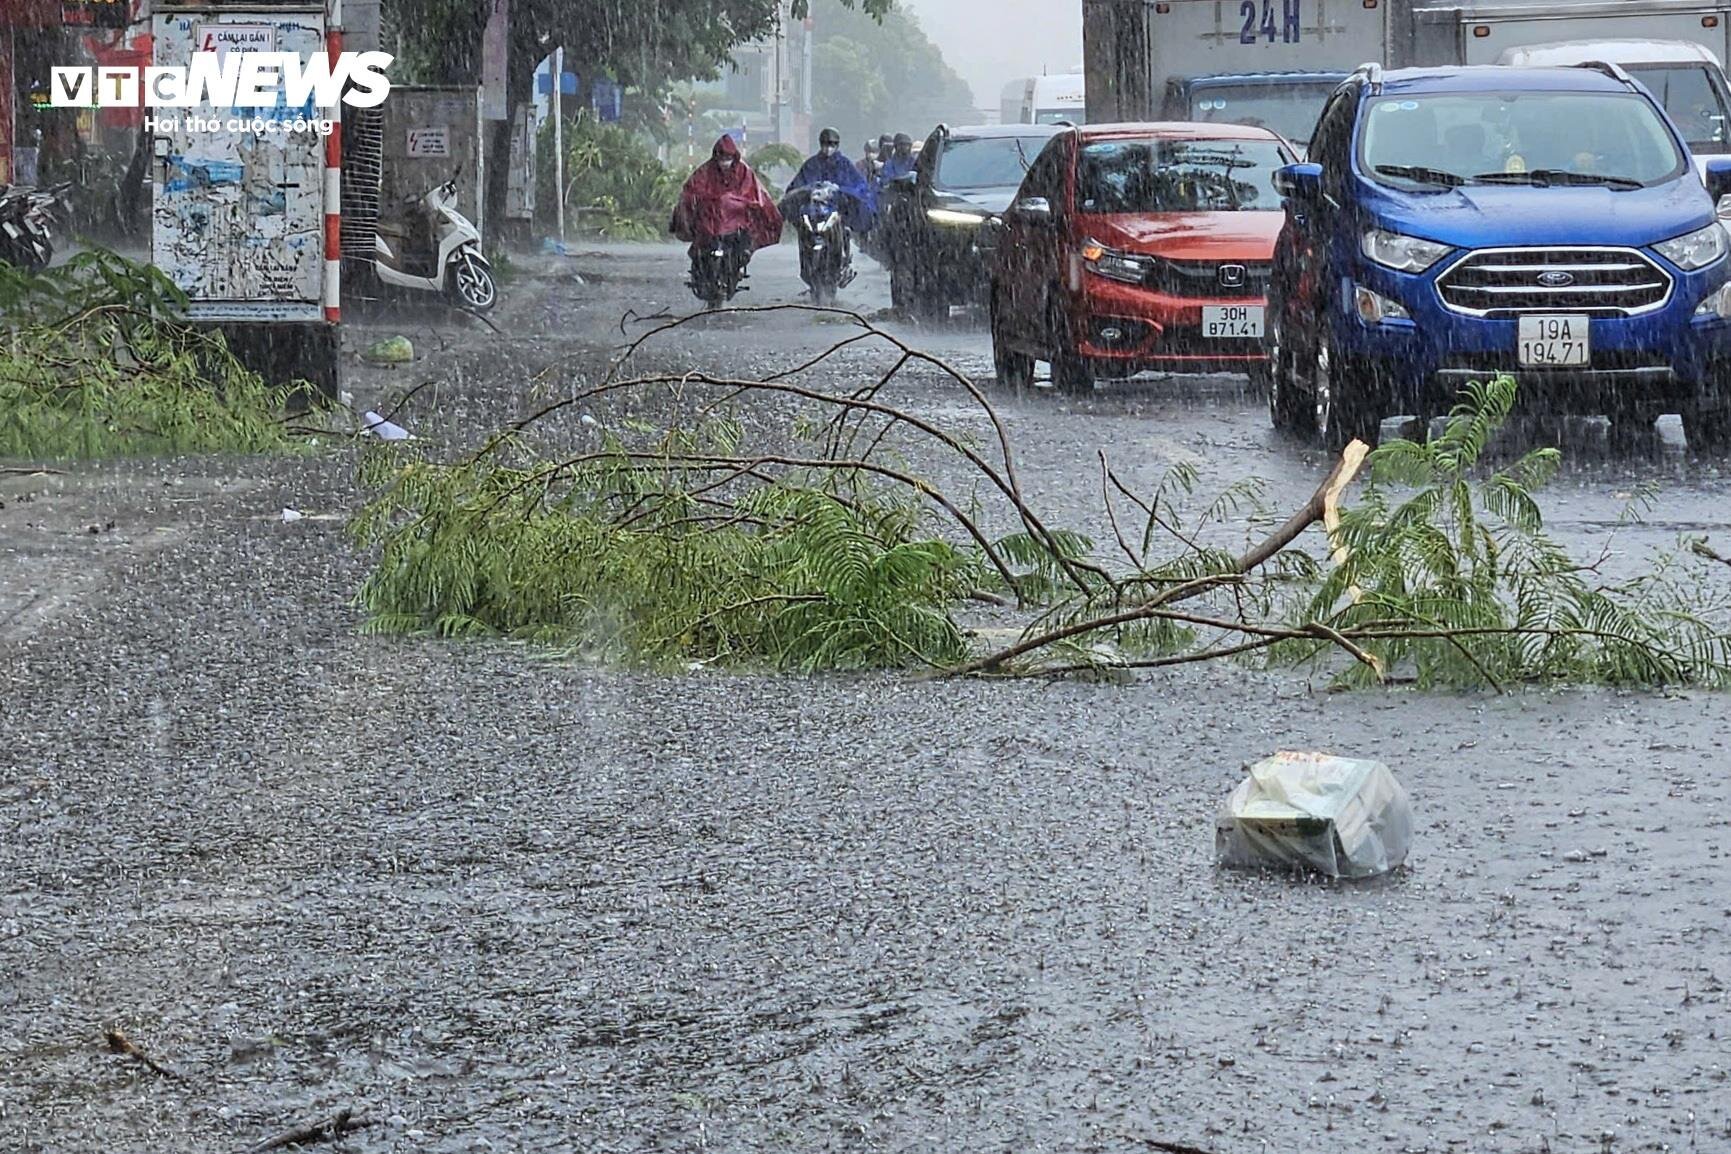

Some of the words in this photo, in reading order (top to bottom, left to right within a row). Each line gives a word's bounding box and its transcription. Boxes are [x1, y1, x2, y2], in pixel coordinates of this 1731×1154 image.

[1240, 0, 1300, 44] 24H
[1220, 307, 1247, 321] 30H
[1209, 322, 1257, 336] 871.41
[1538, 319, 1572, 341] 19A
[1524, 342, 1583, 363] 194.71
